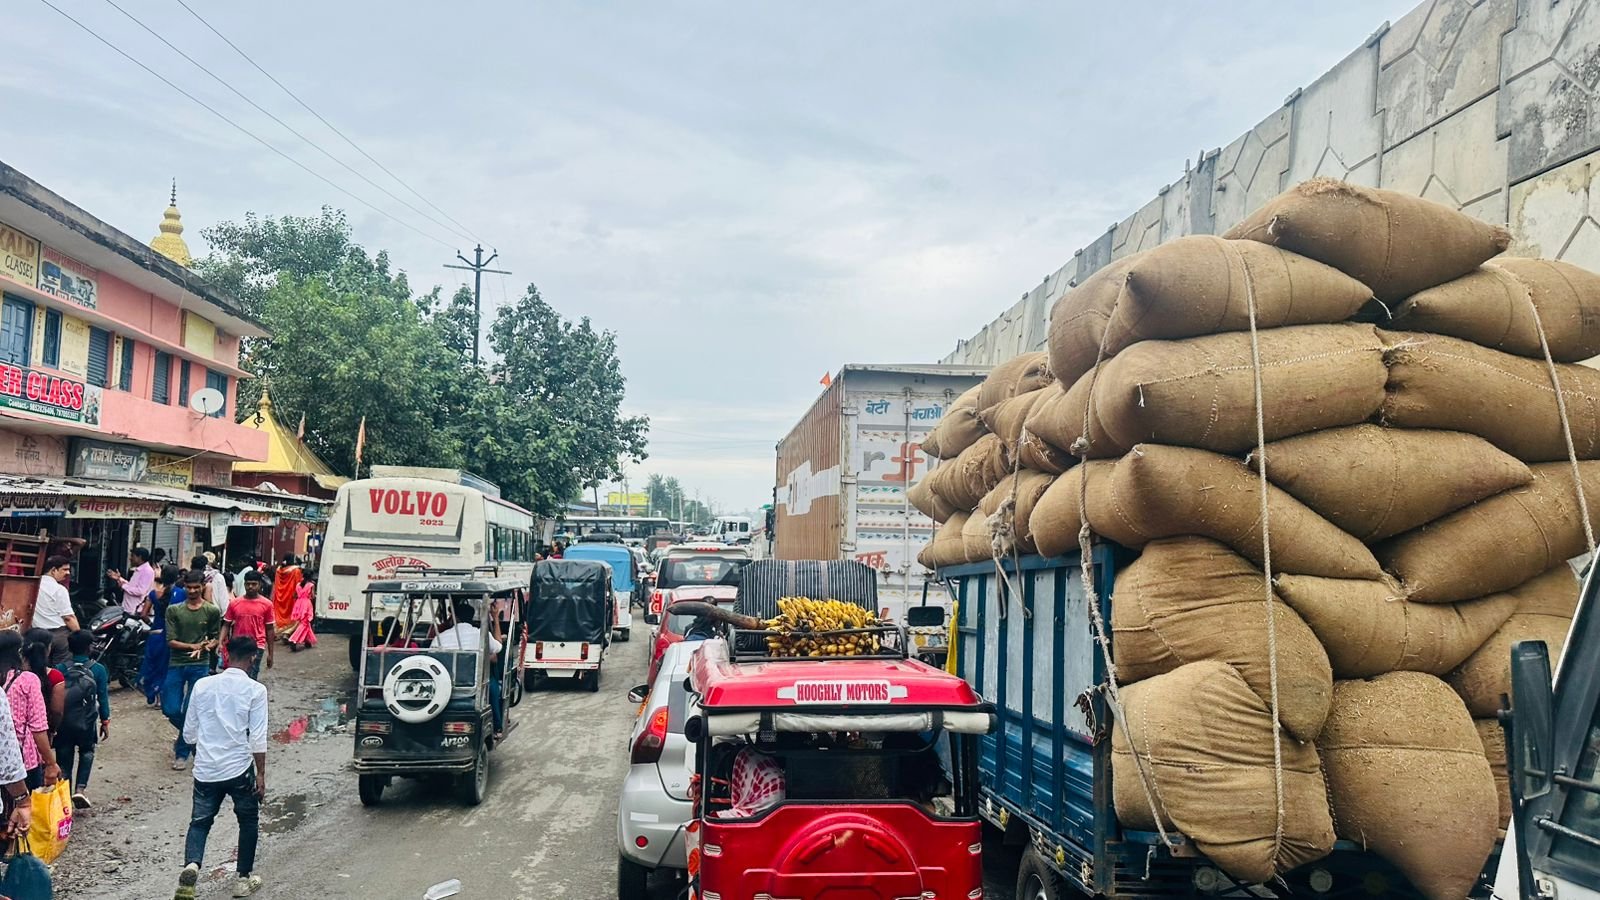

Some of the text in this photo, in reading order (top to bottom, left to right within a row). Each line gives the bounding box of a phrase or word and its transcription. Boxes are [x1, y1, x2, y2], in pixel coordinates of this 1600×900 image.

[5, 254, 34, 280] CLASSES
[26, 371, 84, 411] CLASS
[865, 399, 942, 420] बेटी बचाओ
[369, 488, 447, 517] VOLVO
[419, 518, 444, 527] 2023
[372, 555, 408, 571] आलोक
[328, 602, 350, 611] STOP
[796, 684, 889, 701] HOOGHLY MOTORS
